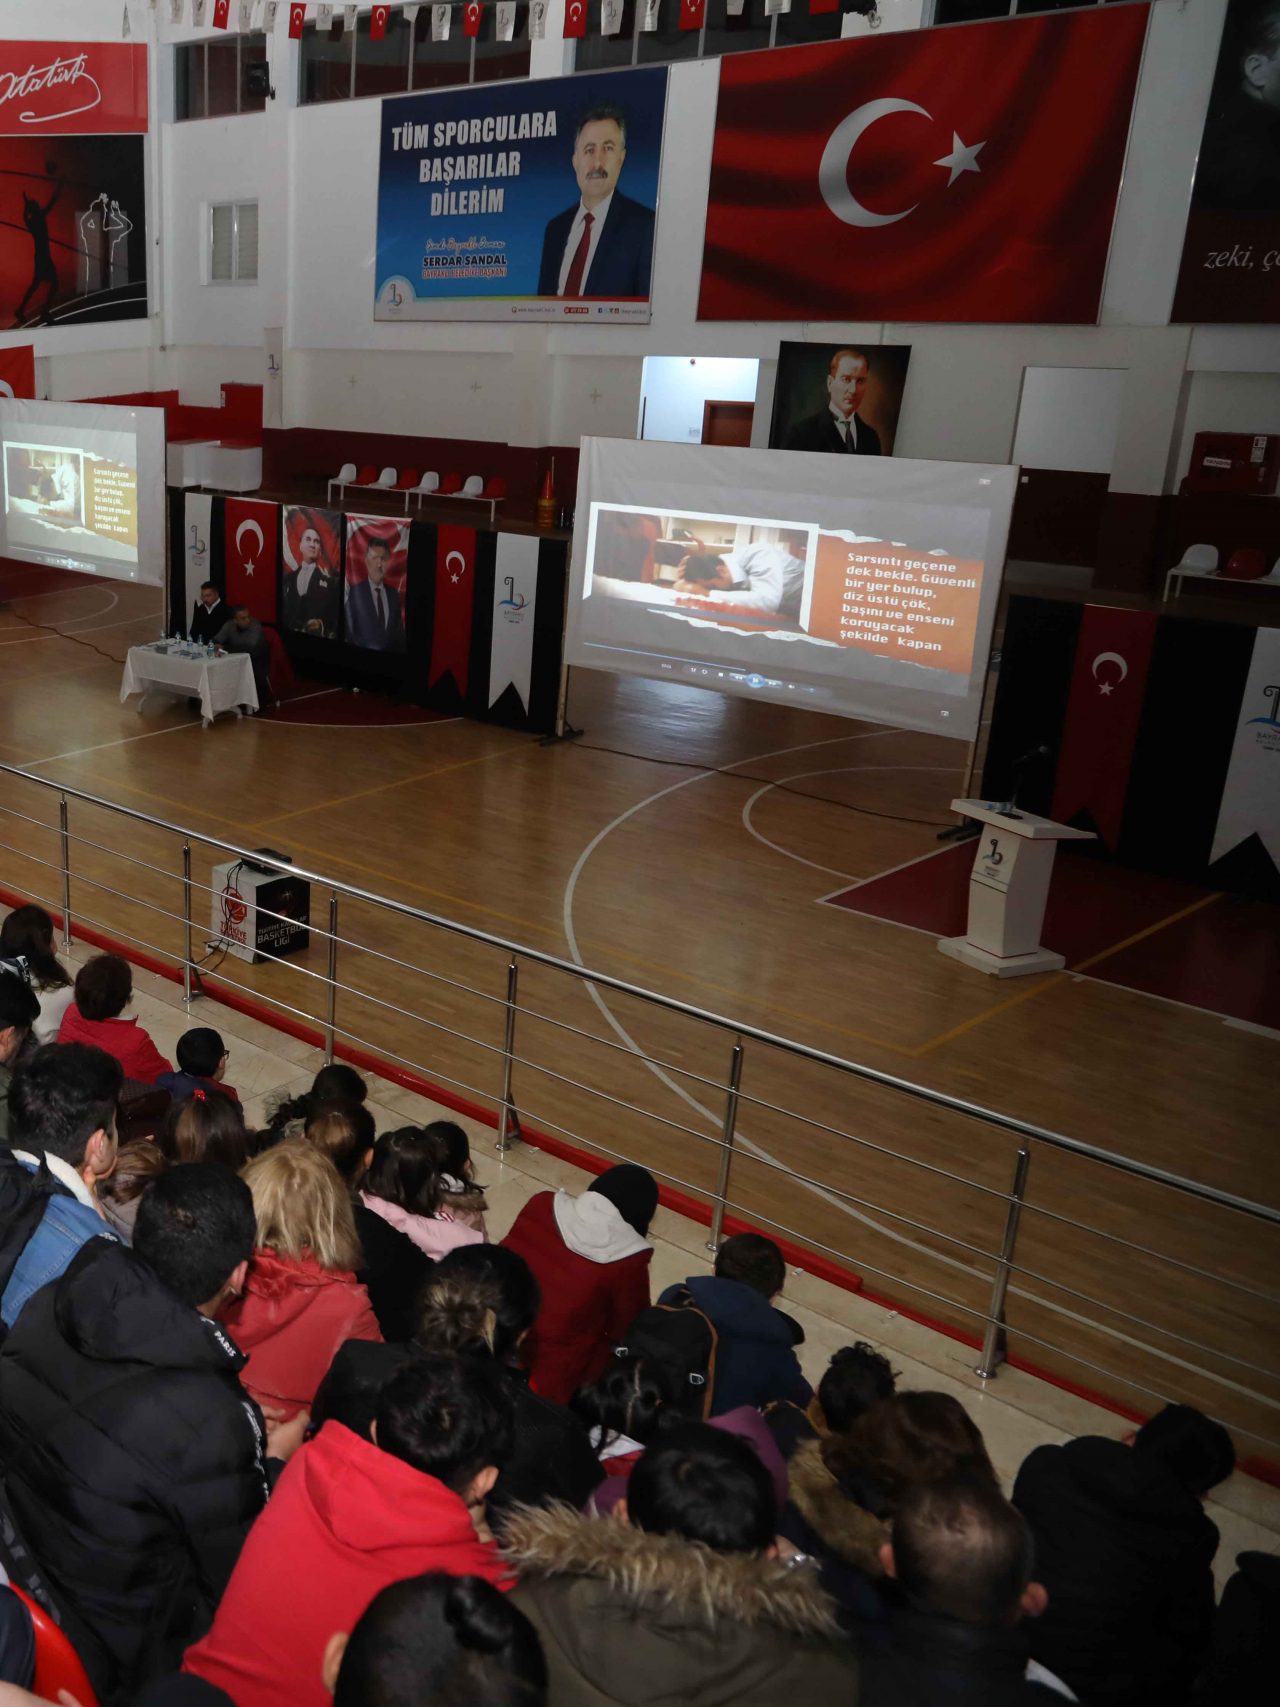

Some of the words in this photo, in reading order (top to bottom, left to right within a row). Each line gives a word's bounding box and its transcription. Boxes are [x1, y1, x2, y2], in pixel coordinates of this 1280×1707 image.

[392, 121, 429, 151] TÜM
[433, 110, 557, 148] SPORCULARA
[419, 151, 521, 185] BAŞARILAR
[430, 185, 505, 216] DİLERİM
[423, 256, 462, 267] SERDAR
[464, 254, 507, 265] SANDAL
[1203, 244, 1254, 269] zeki,
[848, 552, 901, 567] Sarsıntı
[904, 559, 957, 573] geçene
[844, 578, 864, 588] bir
[866, 581, 891, 592] yer
[893, 583, 937, 598] bulup,
[846, 565, 871, 577] dek
[874, 568, 918, 582] bekle.
[921, 573, 976, 588] Güvenli
[843, 591, 864, 601] diz
[867, 594, 898, 607] üstü
[901, 598, 931, 611] çök,
[840, 616, 915, 634] koruyacak
[842, 603, 883, 617] başını
[886, 610, 903, 619] ve
[907, 613, 955, 626] enseni
[839, 628, 889, 644] şekilde
[897, 636, 942, 651] kapan
[214, 1330, 237, 1357] PARIS
